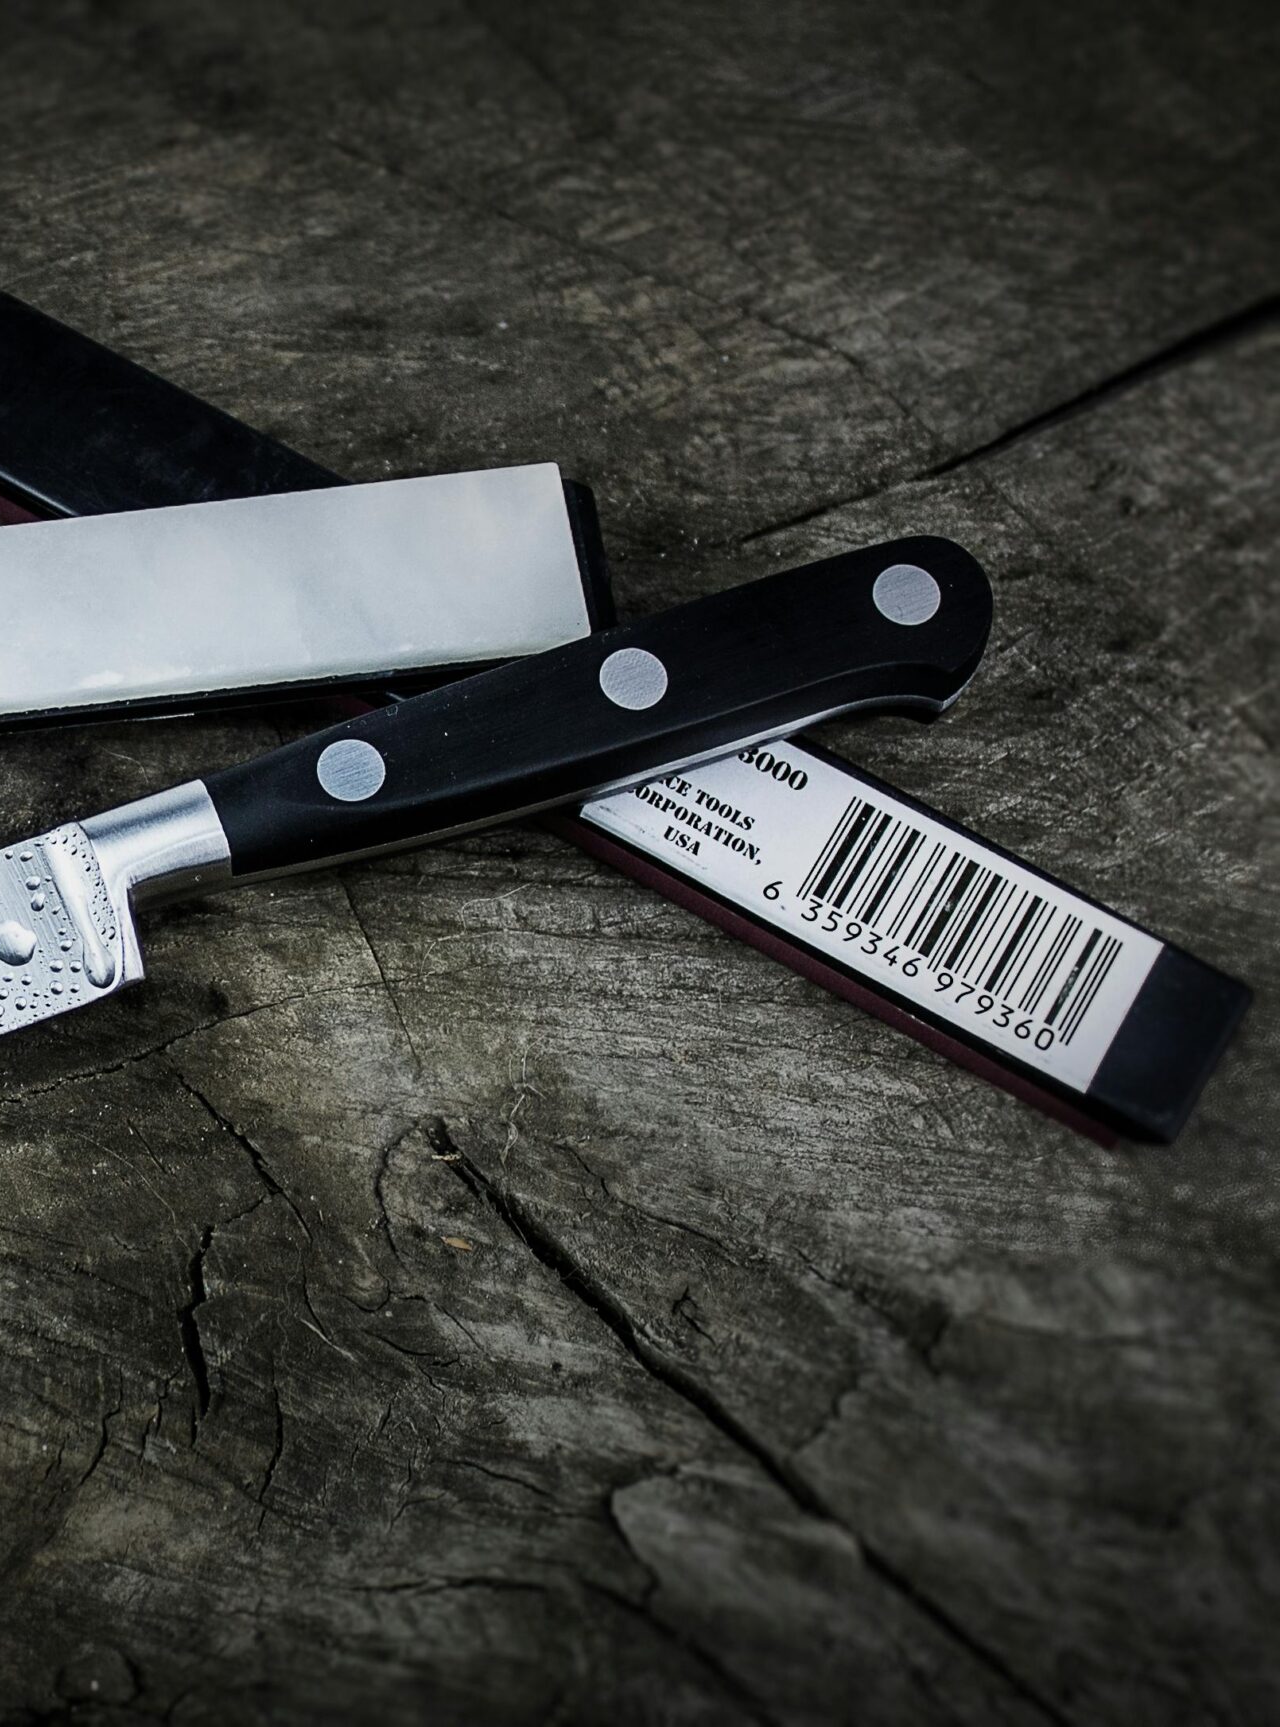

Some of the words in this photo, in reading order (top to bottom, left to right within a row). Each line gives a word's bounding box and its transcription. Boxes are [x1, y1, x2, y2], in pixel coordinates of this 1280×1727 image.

[738, 747, 809, 791] 3000
[627, 785, 762, 866] ORPORATION,
[695, 789, 756, 831] TOOLS
[663, 825, 701, 856] USA
[763, 881, 783, 900] 6
[801, 898, 922, 977] 359346
[934, 972, 1055, 1051] 979360
